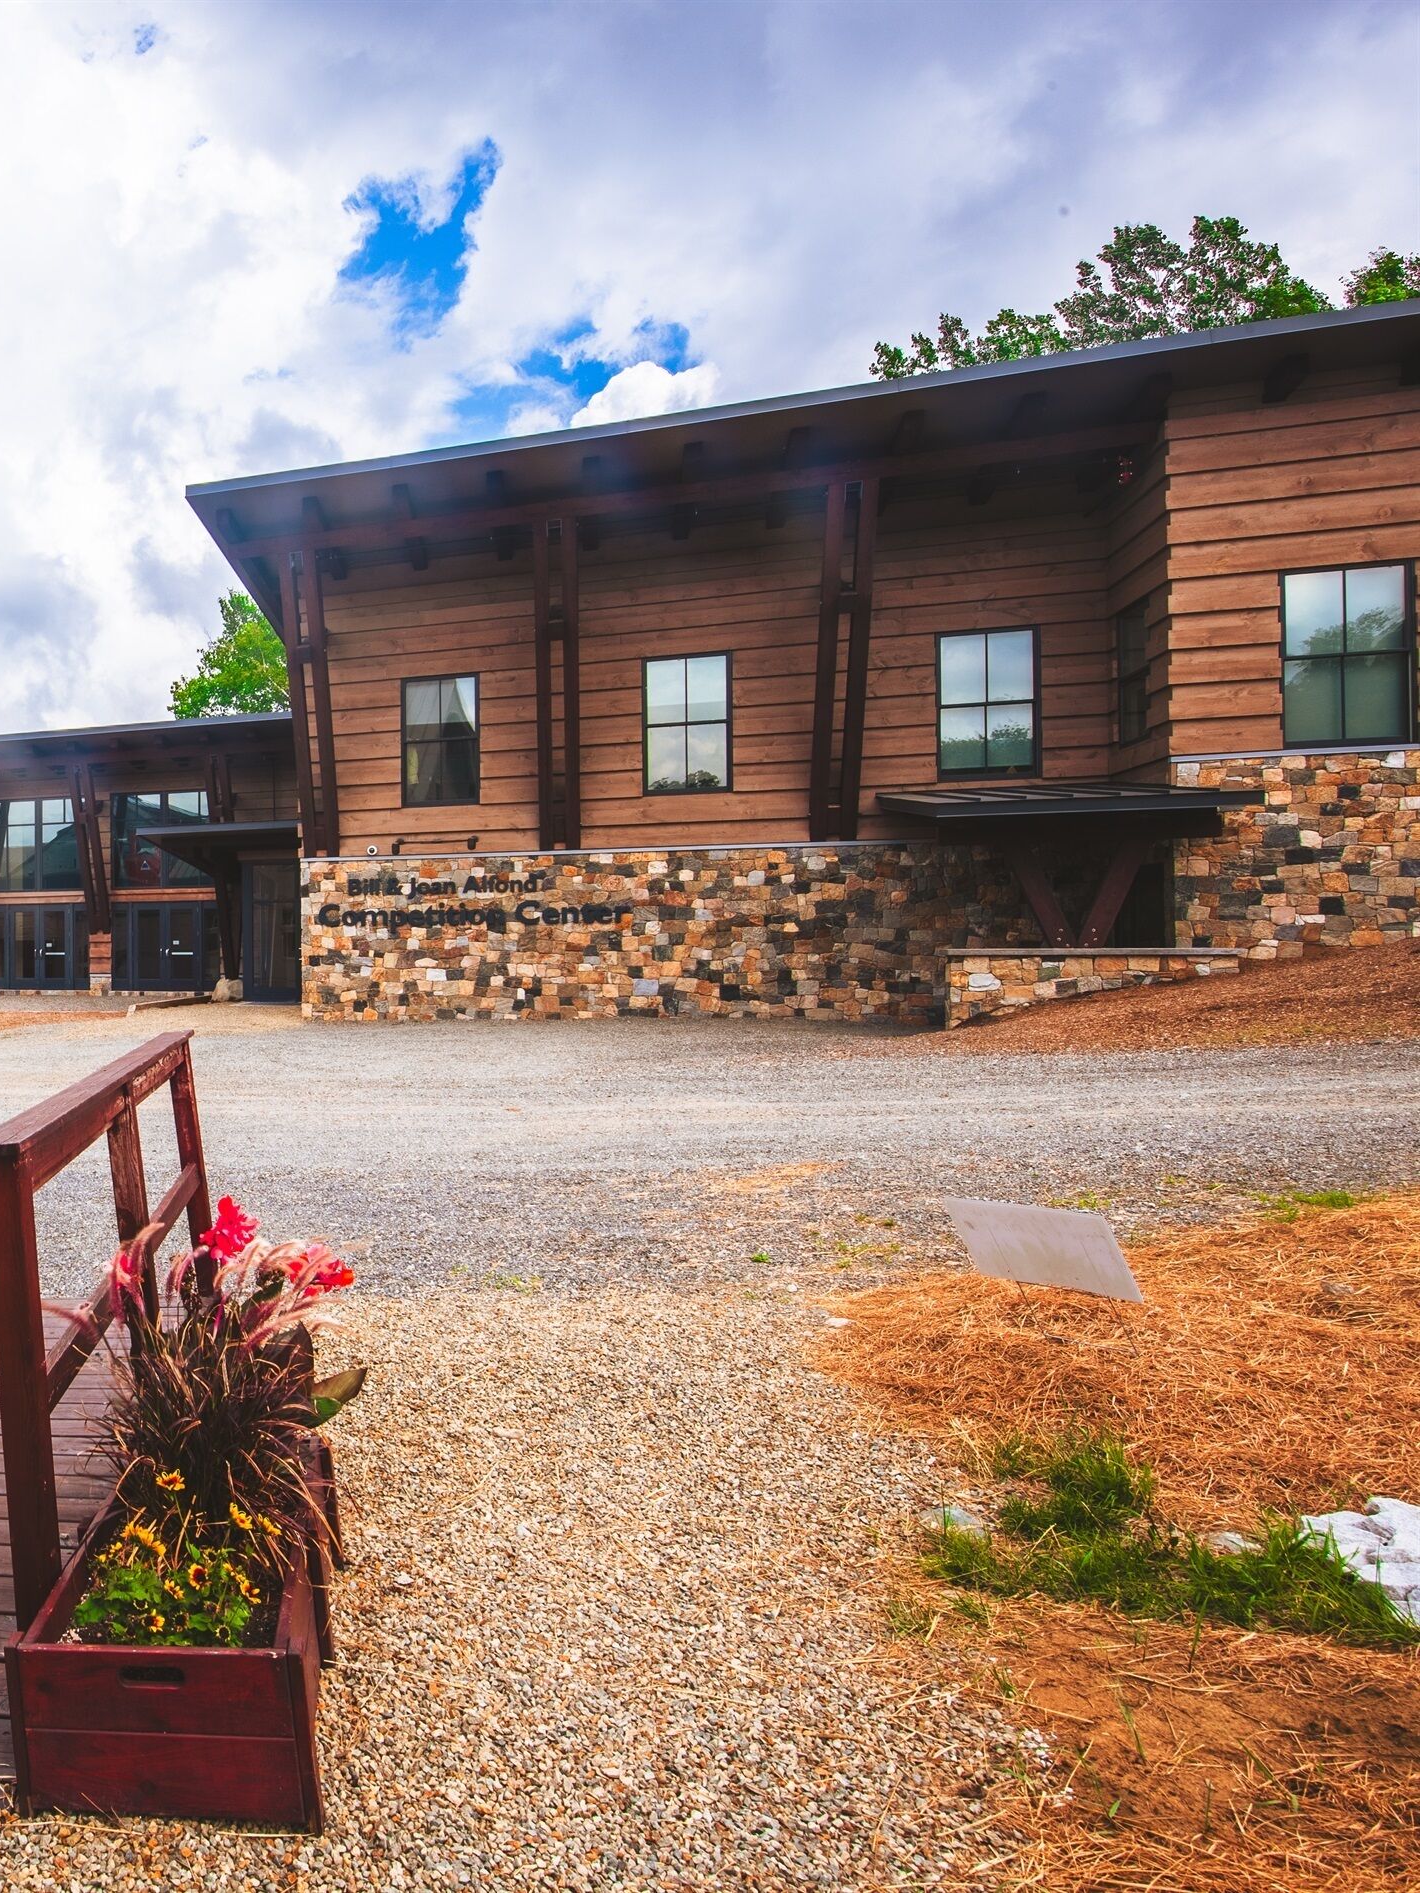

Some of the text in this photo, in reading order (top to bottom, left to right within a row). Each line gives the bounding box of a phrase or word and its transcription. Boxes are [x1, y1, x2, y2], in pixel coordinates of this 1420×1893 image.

[348, 879, 379, 896] Bill
[387, 877, 403, 895] &
[463, 874, 537, 894] Alfond
[319, 900, 628, 934] Competition Center
